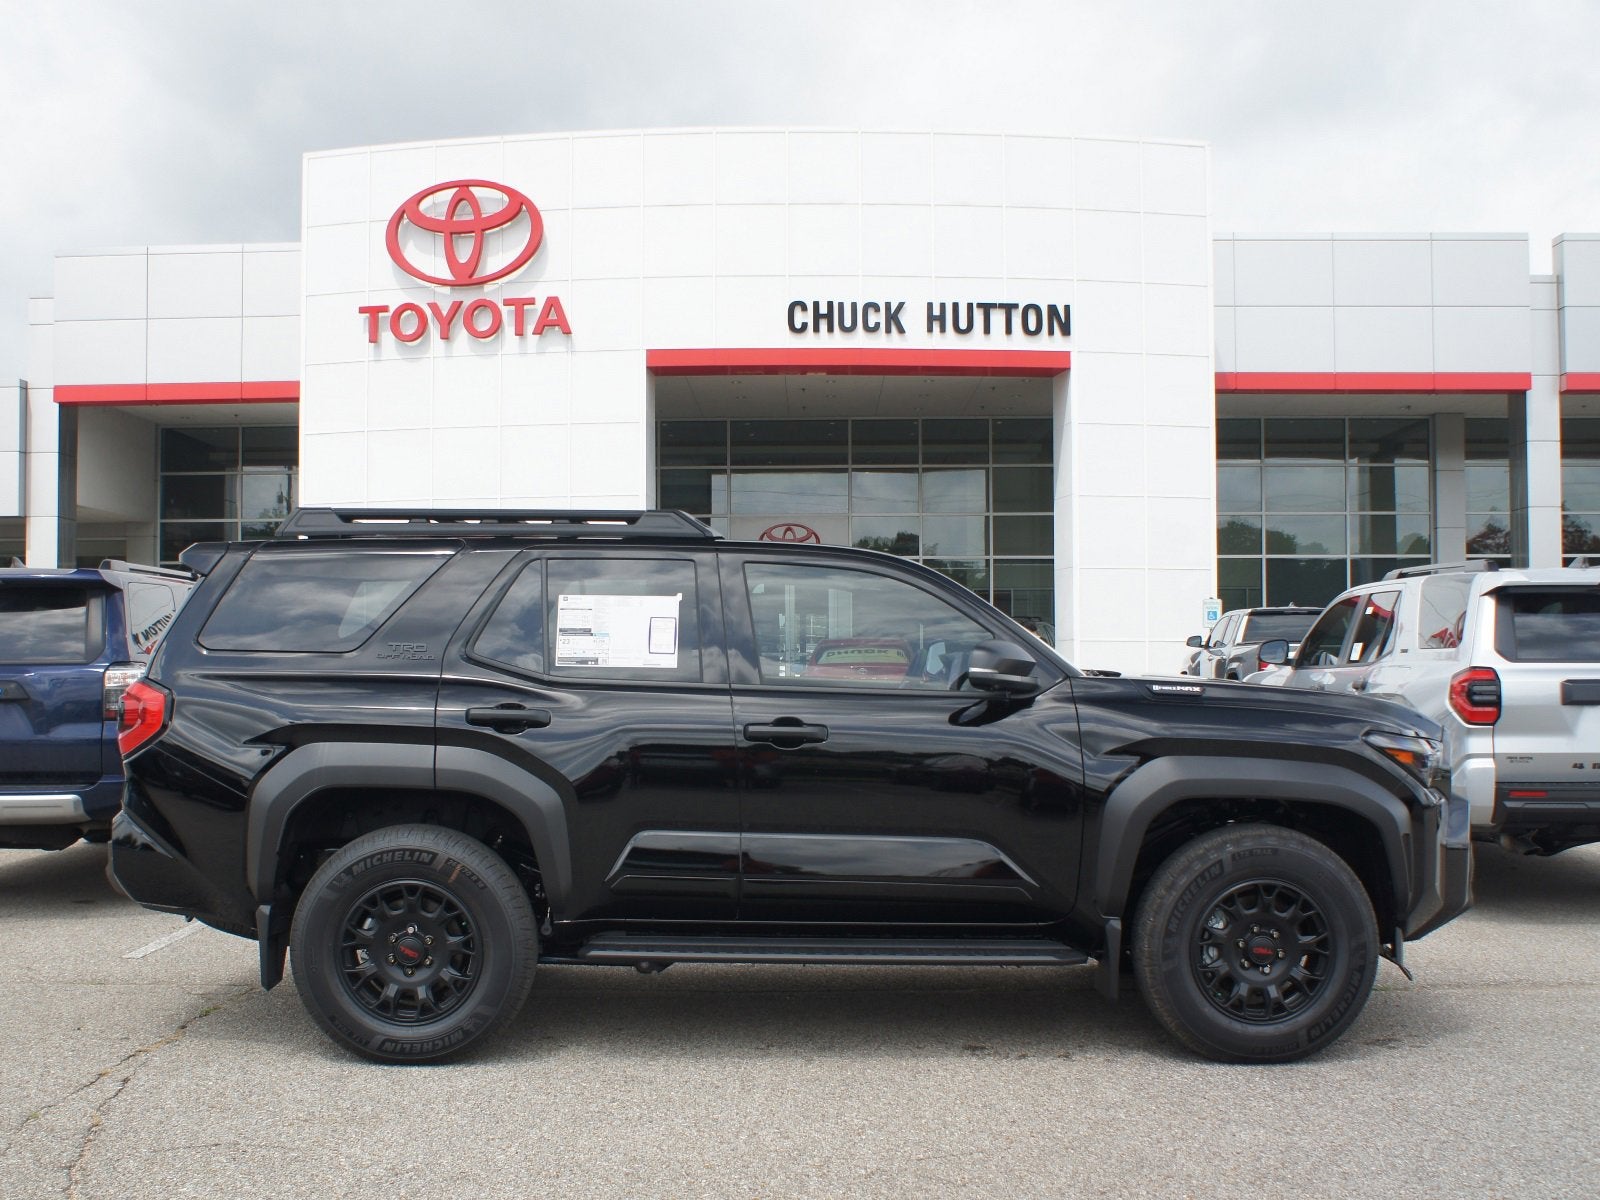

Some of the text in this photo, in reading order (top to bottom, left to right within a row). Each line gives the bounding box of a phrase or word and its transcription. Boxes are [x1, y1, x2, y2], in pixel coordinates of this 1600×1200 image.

[358, 295, 572, 344] TOYOTA
[787, 300, 1071, 337] CHUCK HUTTON
[387, 642, 428, 653] TRD
[352, 850, 433, 876] MICHELIN
[1167, 860, 1223, 933] MICHELIN
